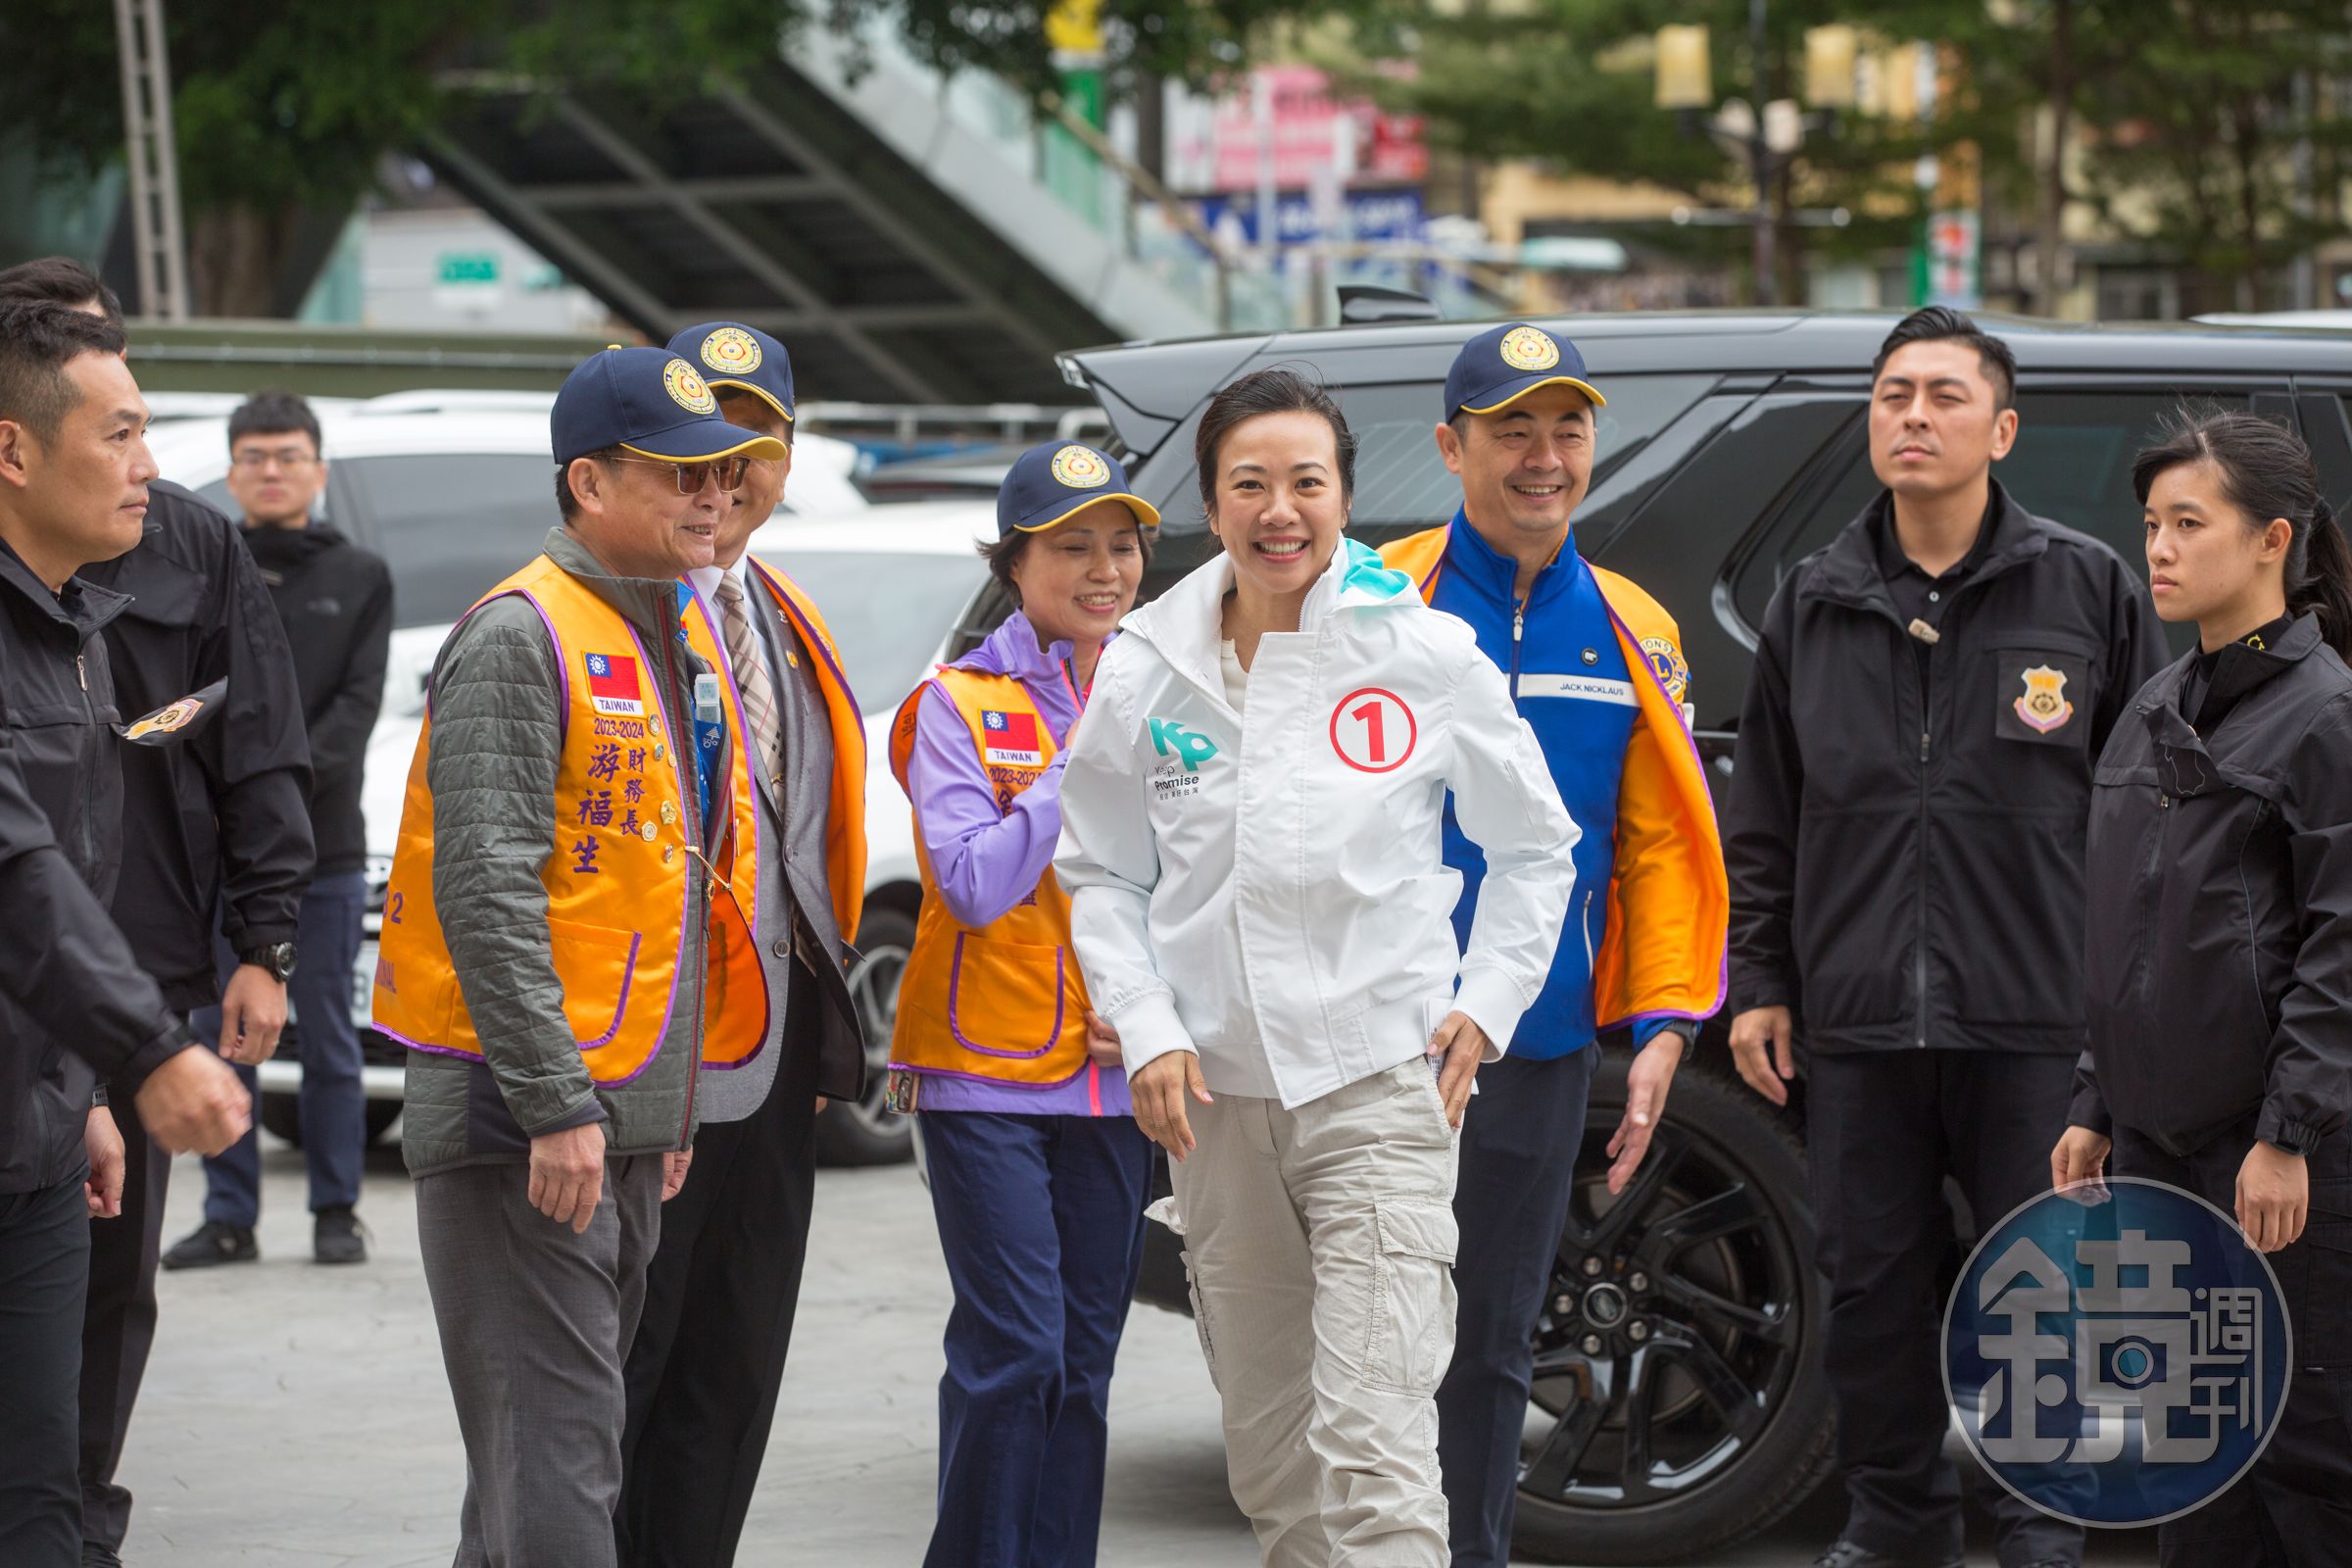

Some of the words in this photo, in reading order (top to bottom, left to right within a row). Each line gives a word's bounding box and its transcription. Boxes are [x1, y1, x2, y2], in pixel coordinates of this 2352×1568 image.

[1650, 656, 1670, 678] L
[1560, 683, 1583, 692] JACK
[1585, 685, 1624, 696] NICKLAUS
[599, 699, 635, 712] TAIWAN
[594, 717, 645, 739] 2023-2024
[995, 750, 1033, 762] TAIWAN
[989, 767, 1042, 786] 2023-202
[1154, 774, 1200, 791] Promise
[619, 747, 647, 837] 財務長
[571, 743, 621, 874] 游福生
